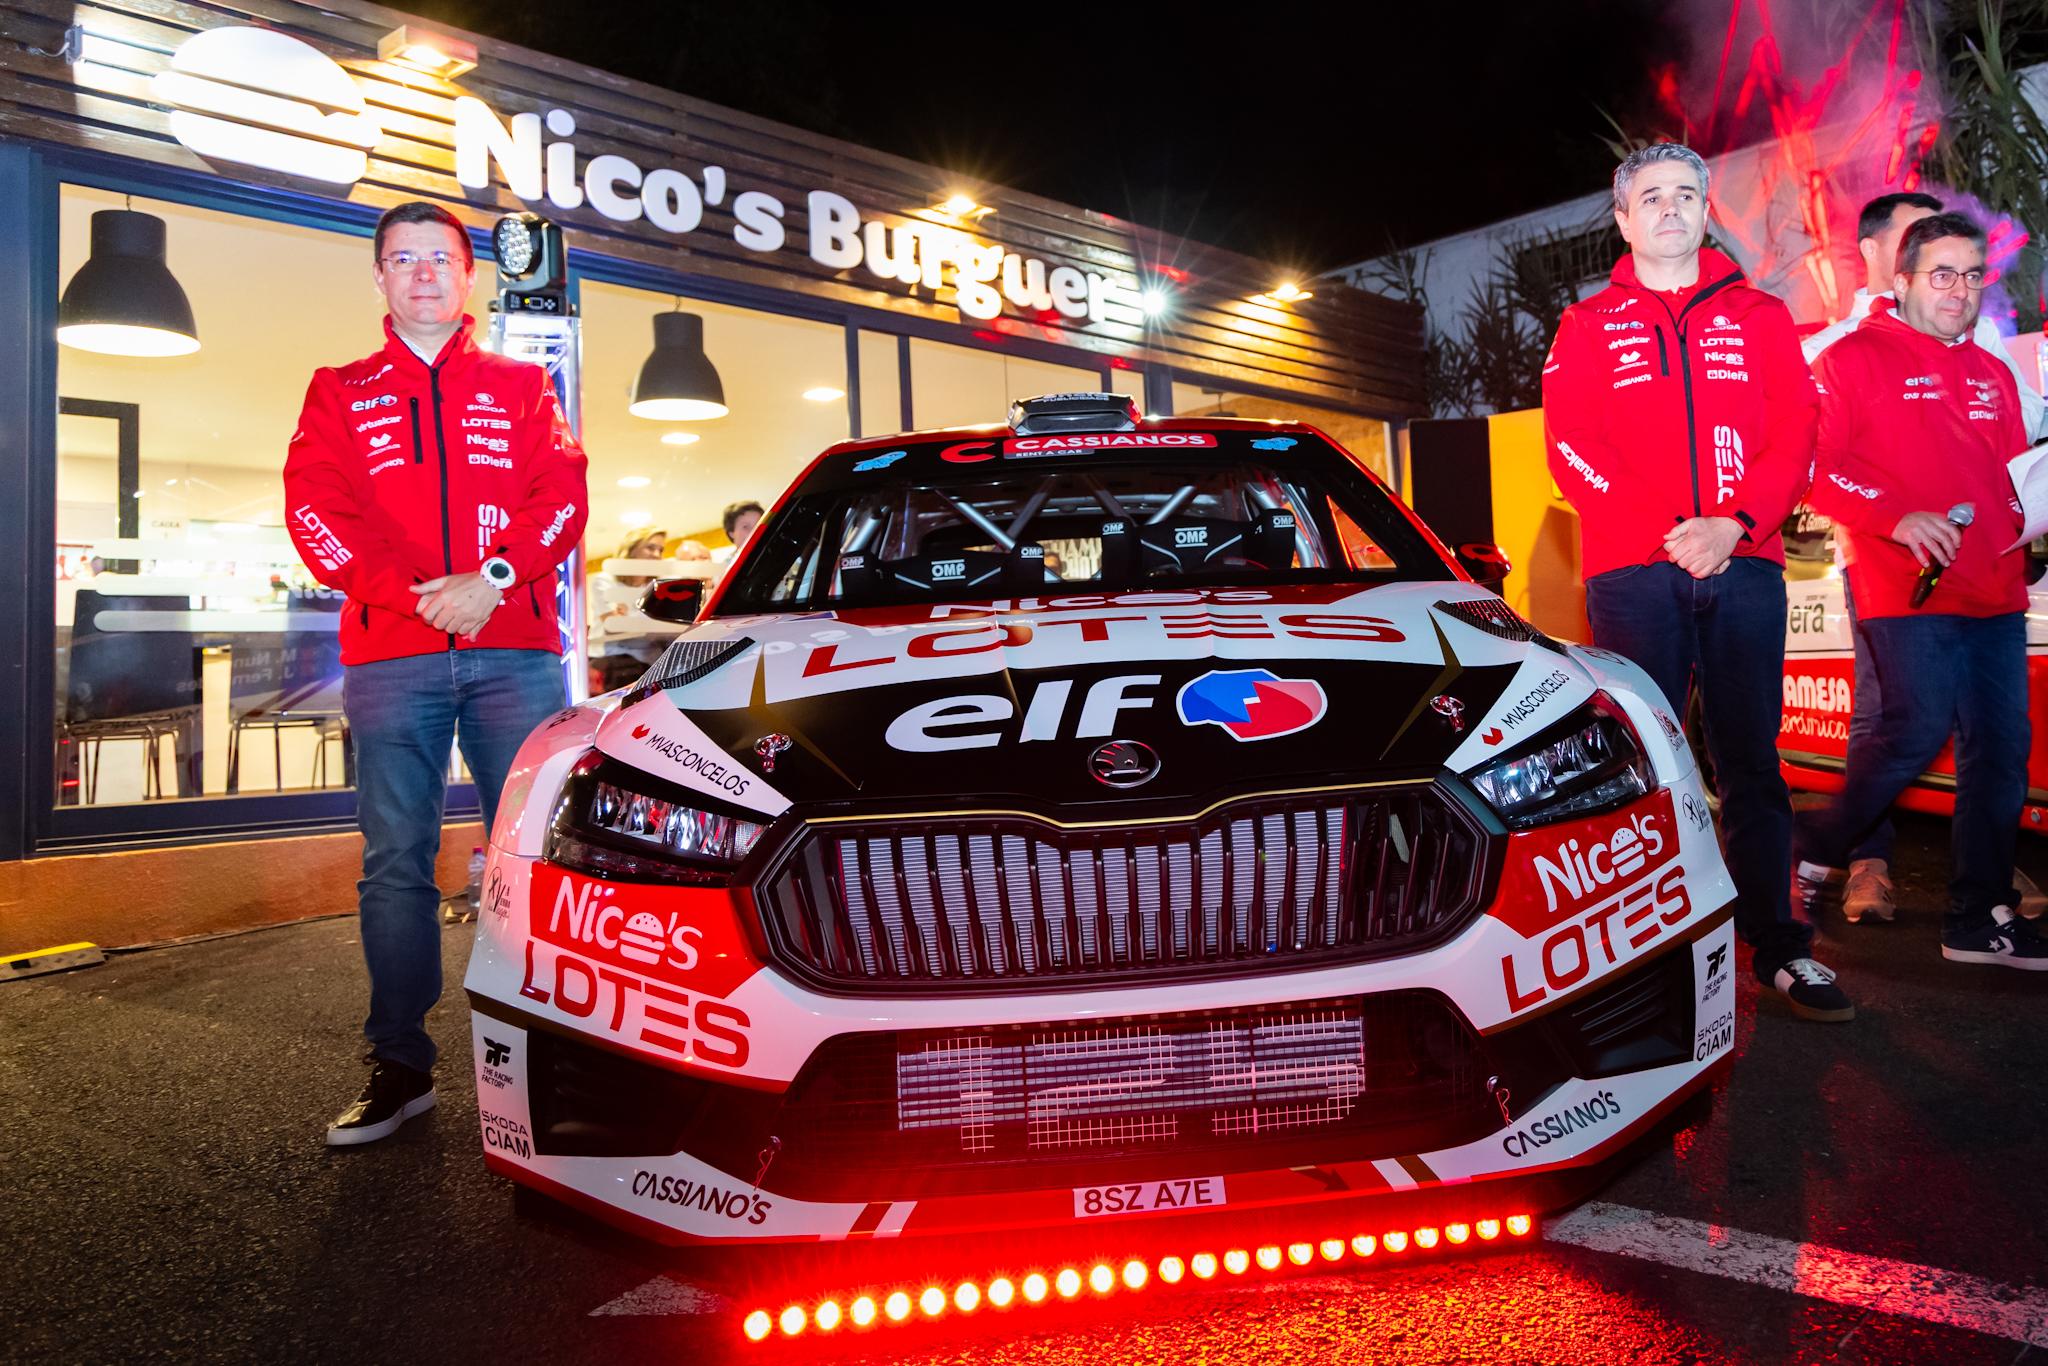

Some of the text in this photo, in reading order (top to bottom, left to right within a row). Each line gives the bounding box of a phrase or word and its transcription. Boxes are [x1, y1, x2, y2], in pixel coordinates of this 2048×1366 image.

[455, 96, 1120, 324] Nico's Burguer
[1603, 322, 1630, 331] elf
[1608, 335, 1651, 350] virtualcar
[1699, 337, 1745, 347] LOTES
[1718, 369, 1749, 383] Diera
[351, 396, 380, 412] elf
[461, 418, 512, 430] LOTES
[1015, 434, 1207, 451] CASSIANO'S
[1016, 450, 1042, 458] RENT
[1556, 440, 1611, 494] virtualcar
[1102, 522, 1124, 534] OMP
[1273, 515, 1294, 526] OMP
[294, 504, 354, 566] LOTES
[1174, 530, 1208, 545] OMP
[841, 558, 864, 568] OMP
[1020, 546, 1044, 557] OMP
[931, 564, 966, 577] OMP
[1788, 603, 1825, 634] era
[802, 612, 1407, 678] LOTES
[1500, 669, 1570, 730] MVASCONCELOS
[1783, 674, 1852, 714] AMESA
[884, 674, 1163, 753] elf
[646, 732, 750, 797] MVASCONCELOS
[1500, 864, 1692, 1014] LOTES
[519, 939, 751, 1068] LOTES
[1696, 1024, 1732, 1062] CIAM
[481, 1075, 506, 1090] FACTORY
[483, 1066, 514, 1085] THE RACING
[1502, 1090, 1622, 1158] CASSIANO'S
[485, 1126, 532, 1160] CIAM
[632, 1170, 773, 1225] CASSIANO'S
[1083, 1178, 1213, 1215] 8SZ A7E
